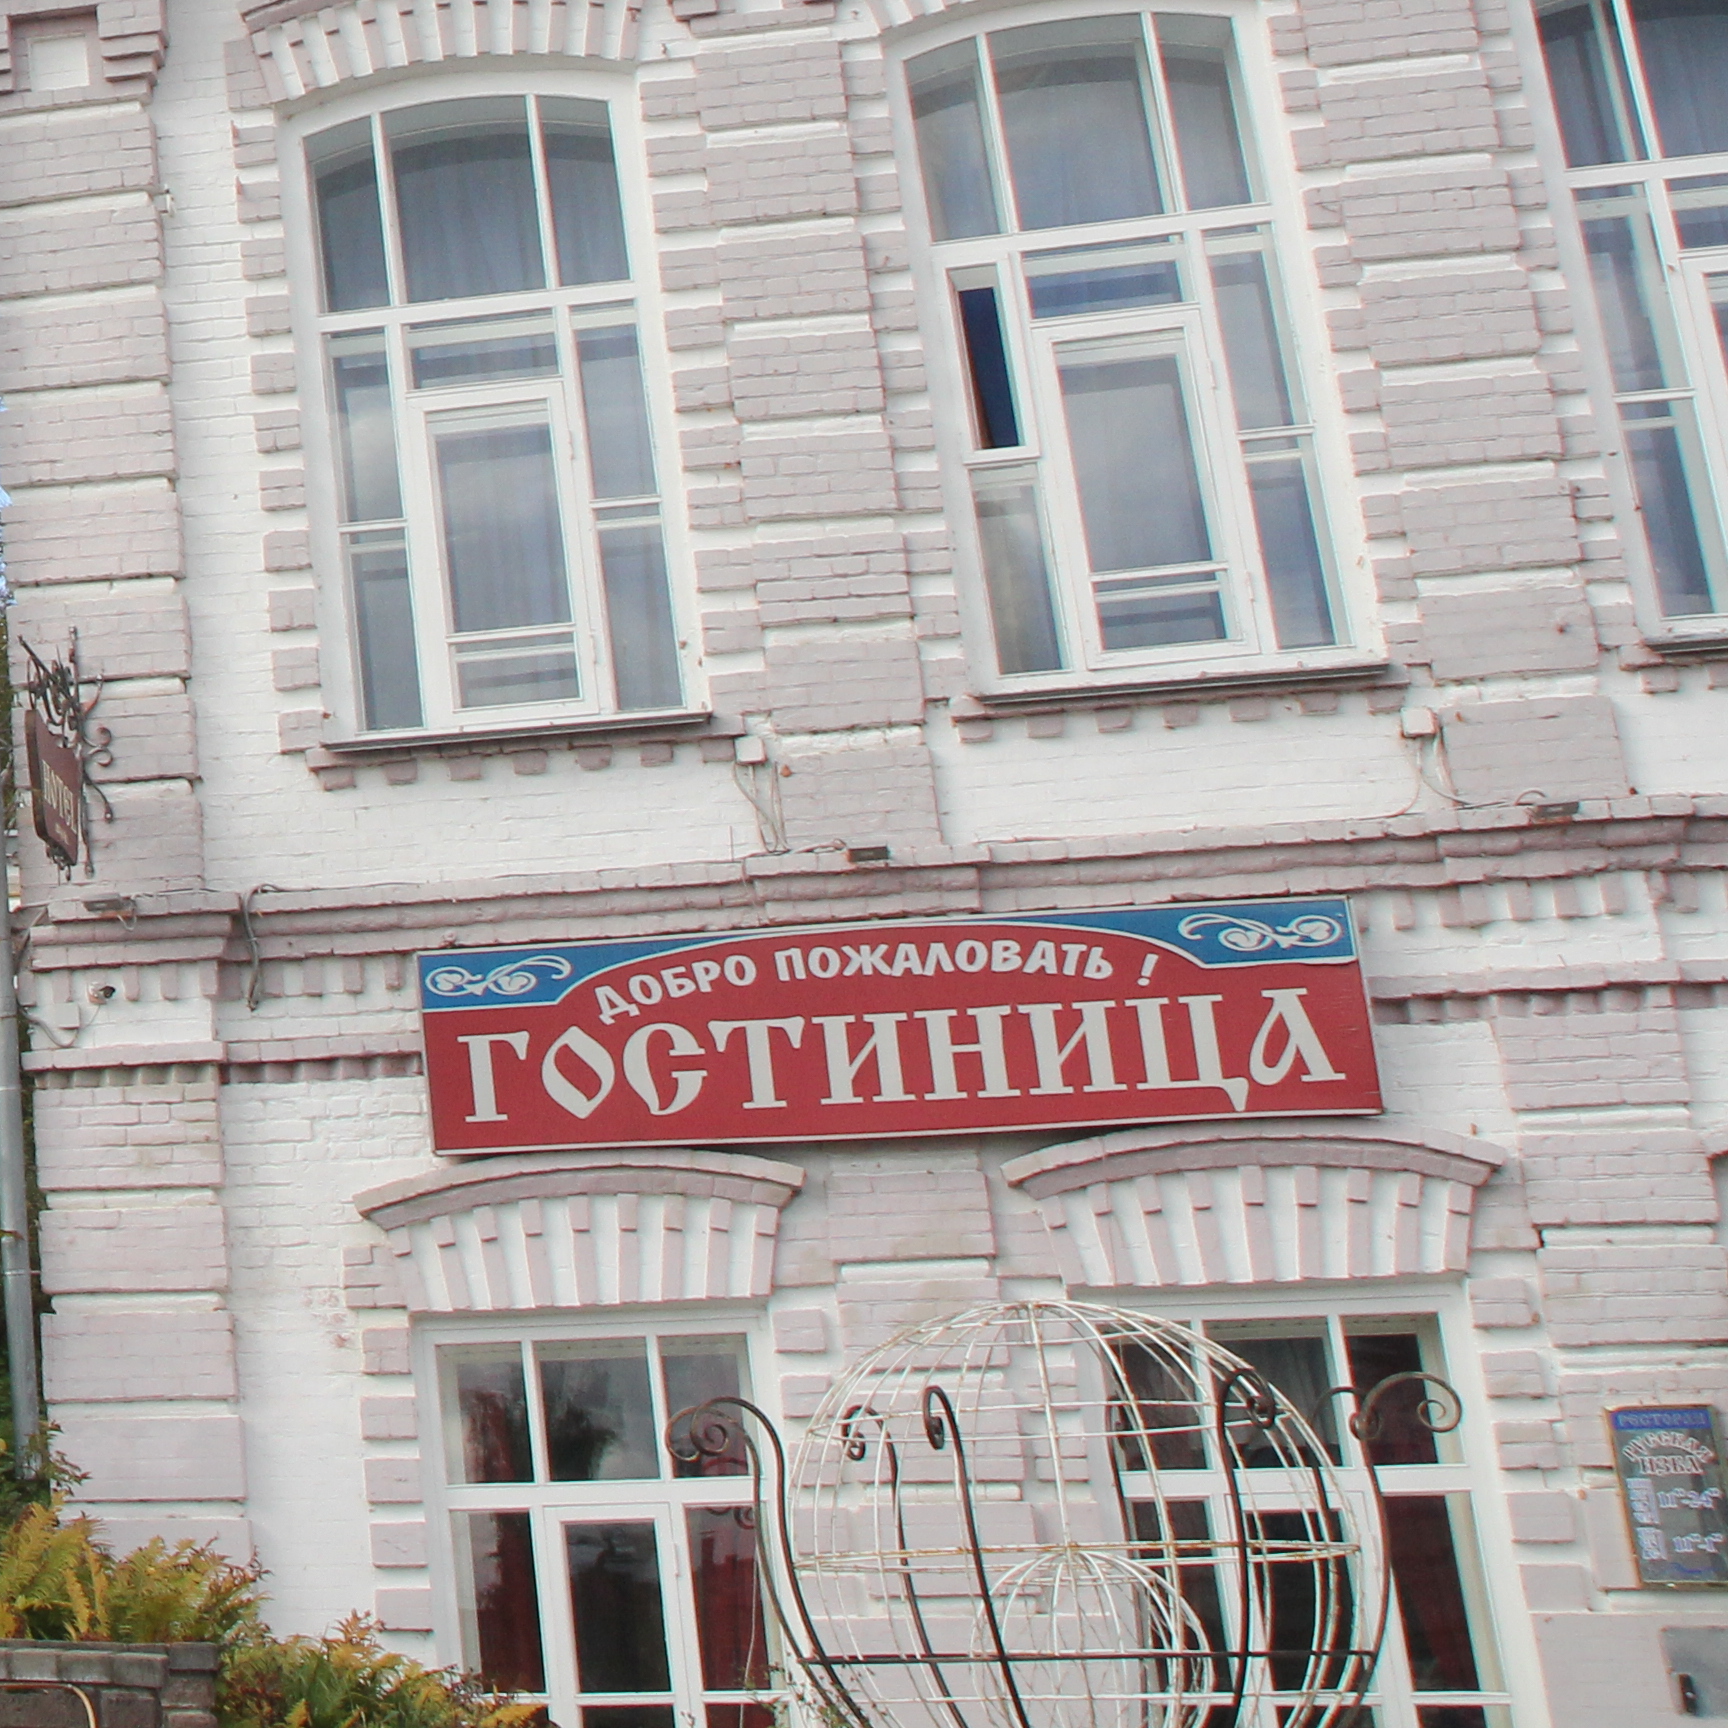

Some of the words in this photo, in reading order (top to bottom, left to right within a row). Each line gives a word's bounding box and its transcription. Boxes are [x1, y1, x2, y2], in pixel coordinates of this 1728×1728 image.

[594, 954, 758, 1026] ДОБРО
[773, 939, 1114, 982] ПОЖАЛОВАТЬ
[456, 987, 1347, 1123] ГОСТИНИЦА
